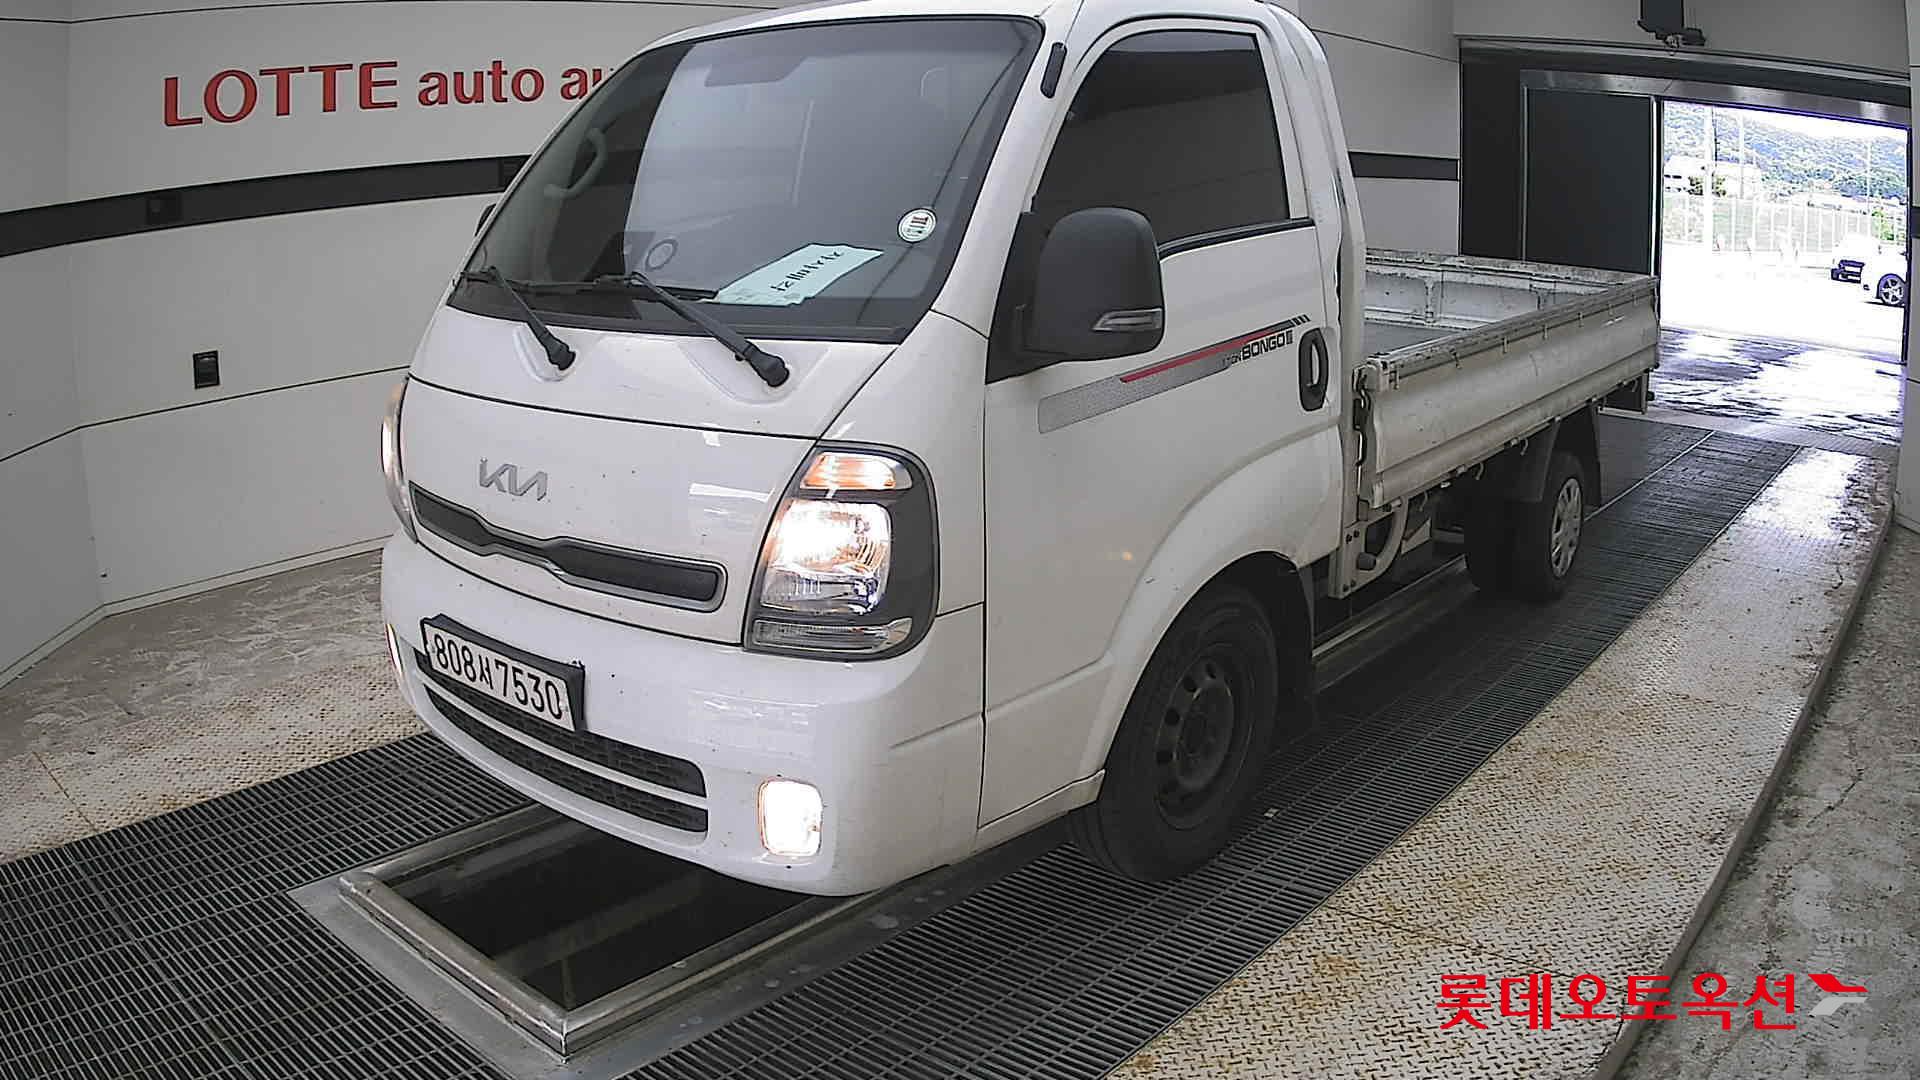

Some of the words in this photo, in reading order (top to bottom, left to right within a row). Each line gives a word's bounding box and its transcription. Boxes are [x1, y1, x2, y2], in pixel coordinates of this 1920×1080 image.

[164, 61, 398, 127] LOTTE
[418, 60, 545, 106] auto
[1242, 333, 1285, 360] BONGO
[480, 458, 548, 502] KIA
